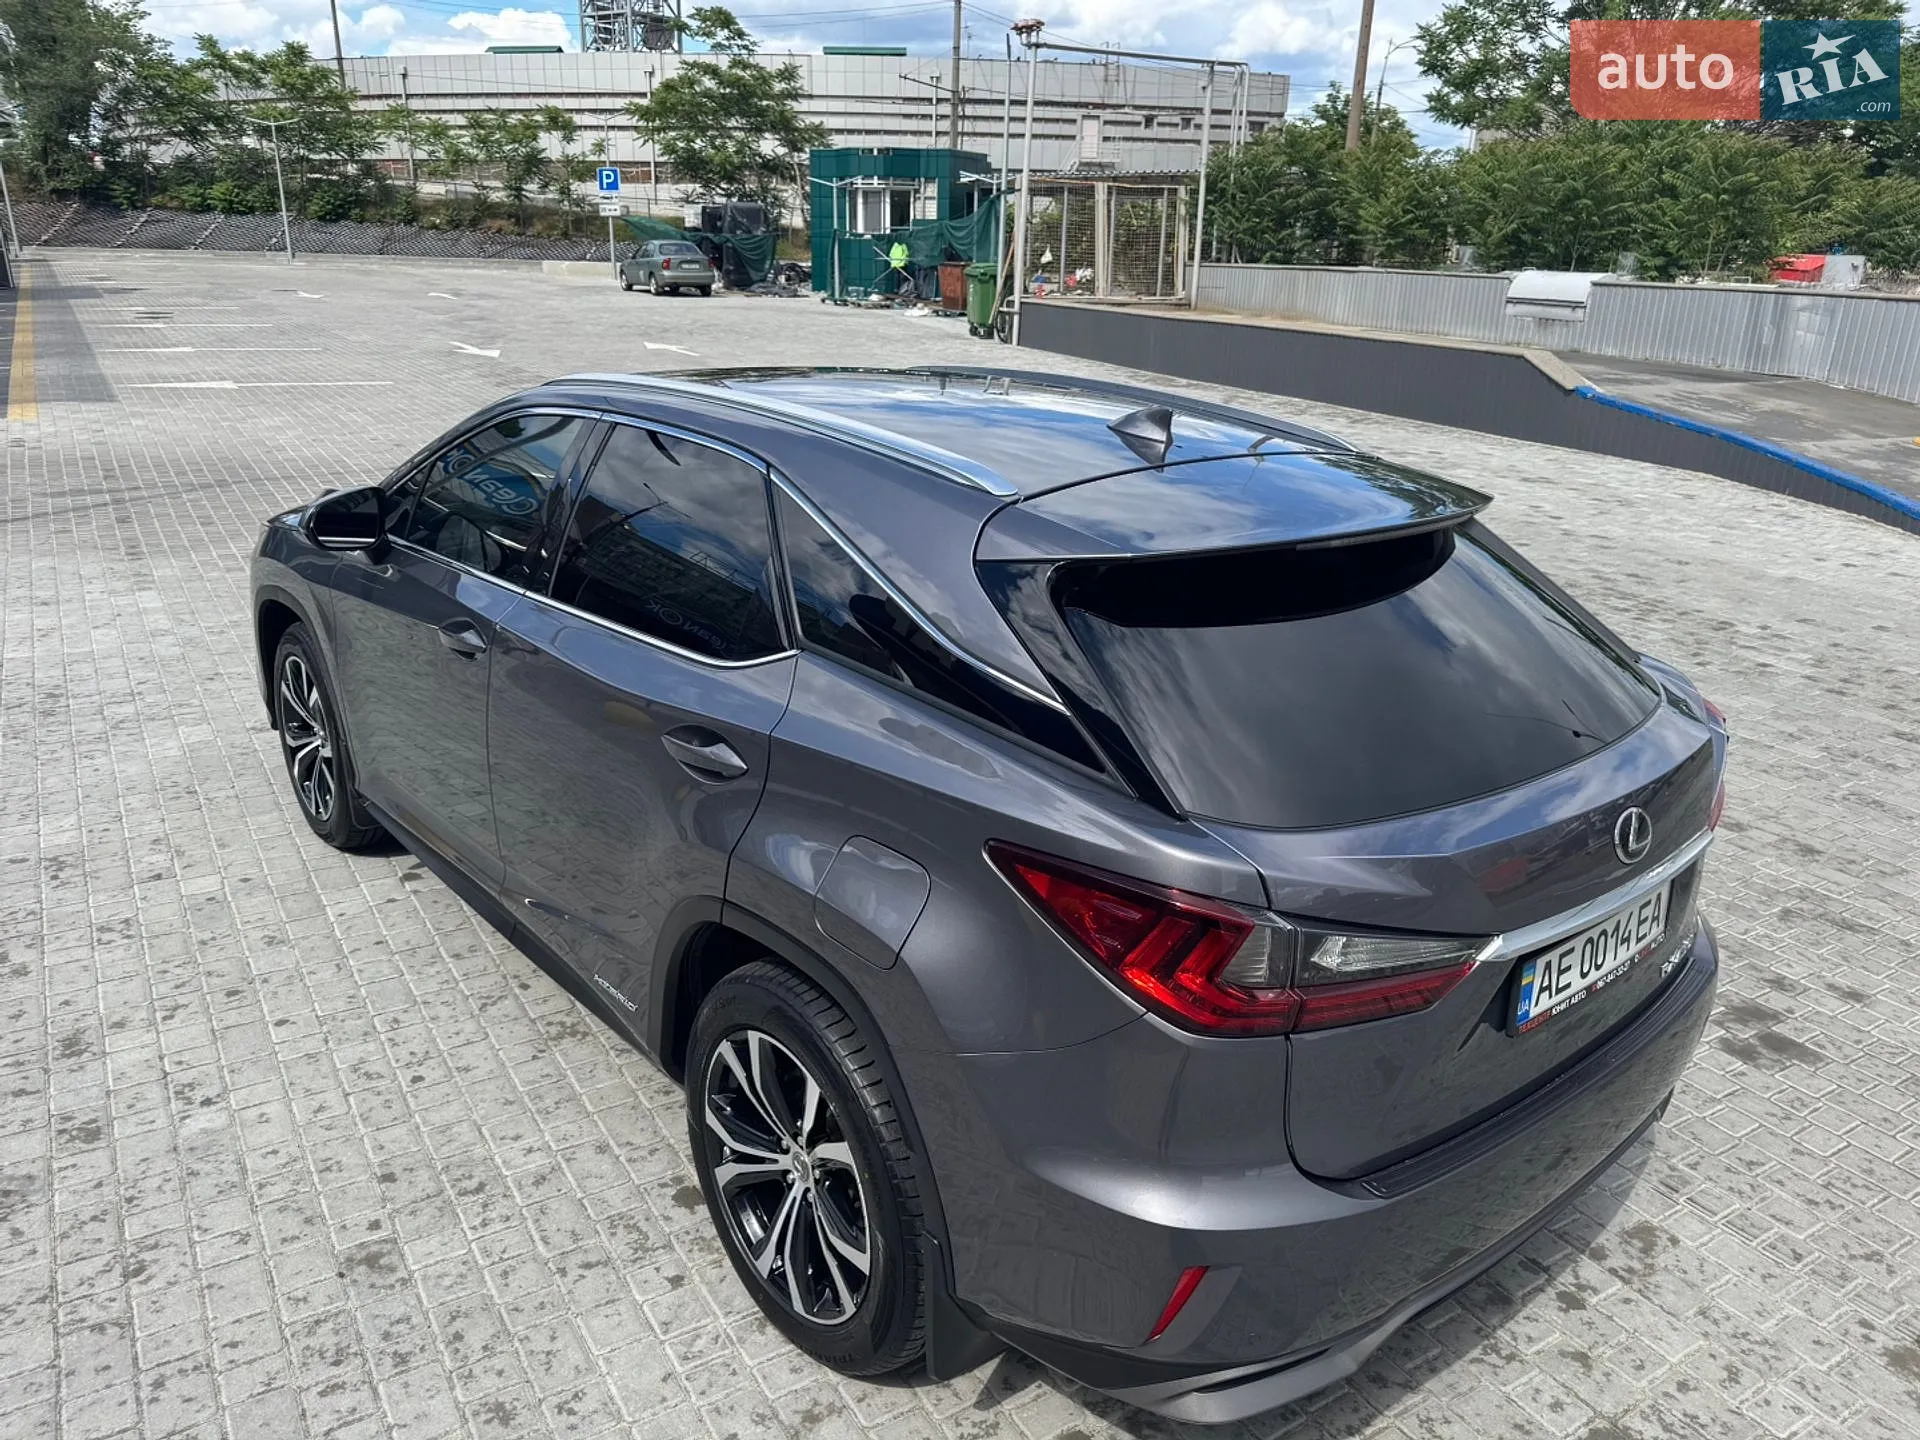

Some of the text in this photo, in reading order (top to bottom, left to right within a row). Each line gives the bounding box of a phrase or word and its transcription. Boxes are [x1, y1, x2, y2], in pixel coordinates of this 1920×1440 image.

[602, 171, 615, 189] P
[1534, 946, 1575, 1008] AE
[1579, 911, 1634, 980] 0014
[1635, 892, 1662, 945] EA
[1517, 998, 1530, 1015] UA
